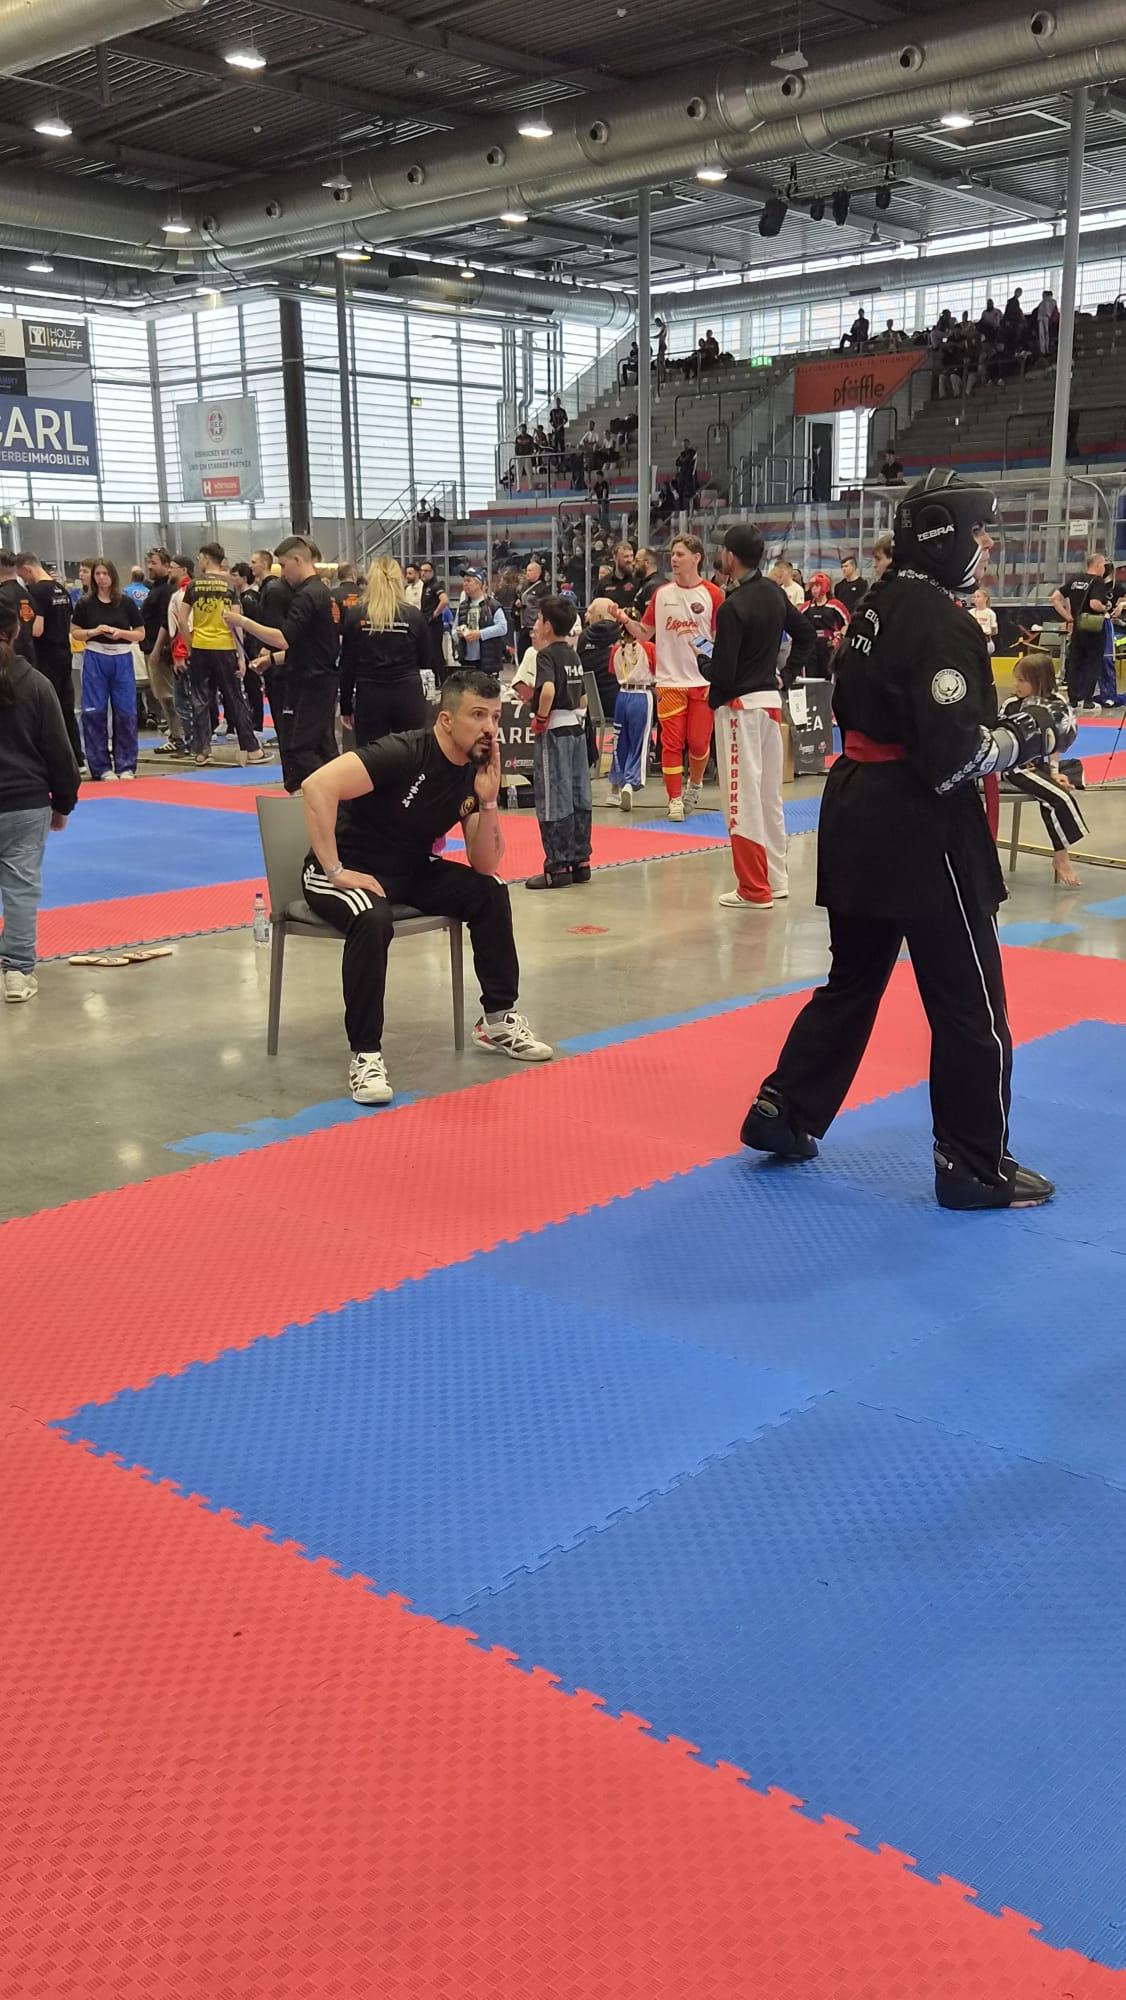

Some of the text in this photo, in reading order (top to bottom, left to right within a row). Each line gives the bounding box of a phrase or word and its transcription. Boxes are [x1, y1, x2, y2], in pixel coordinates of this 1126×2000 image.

[49, 327, 76, 339] HOLZ
[50, 338, 83, 350] HAUFF
[832, 373, 885, 407] pfäffle
[0, 406, 88, 452] ARL
[916, 524, 955, 542] ZEBRA
[495, 726, 536, 745] ARE
